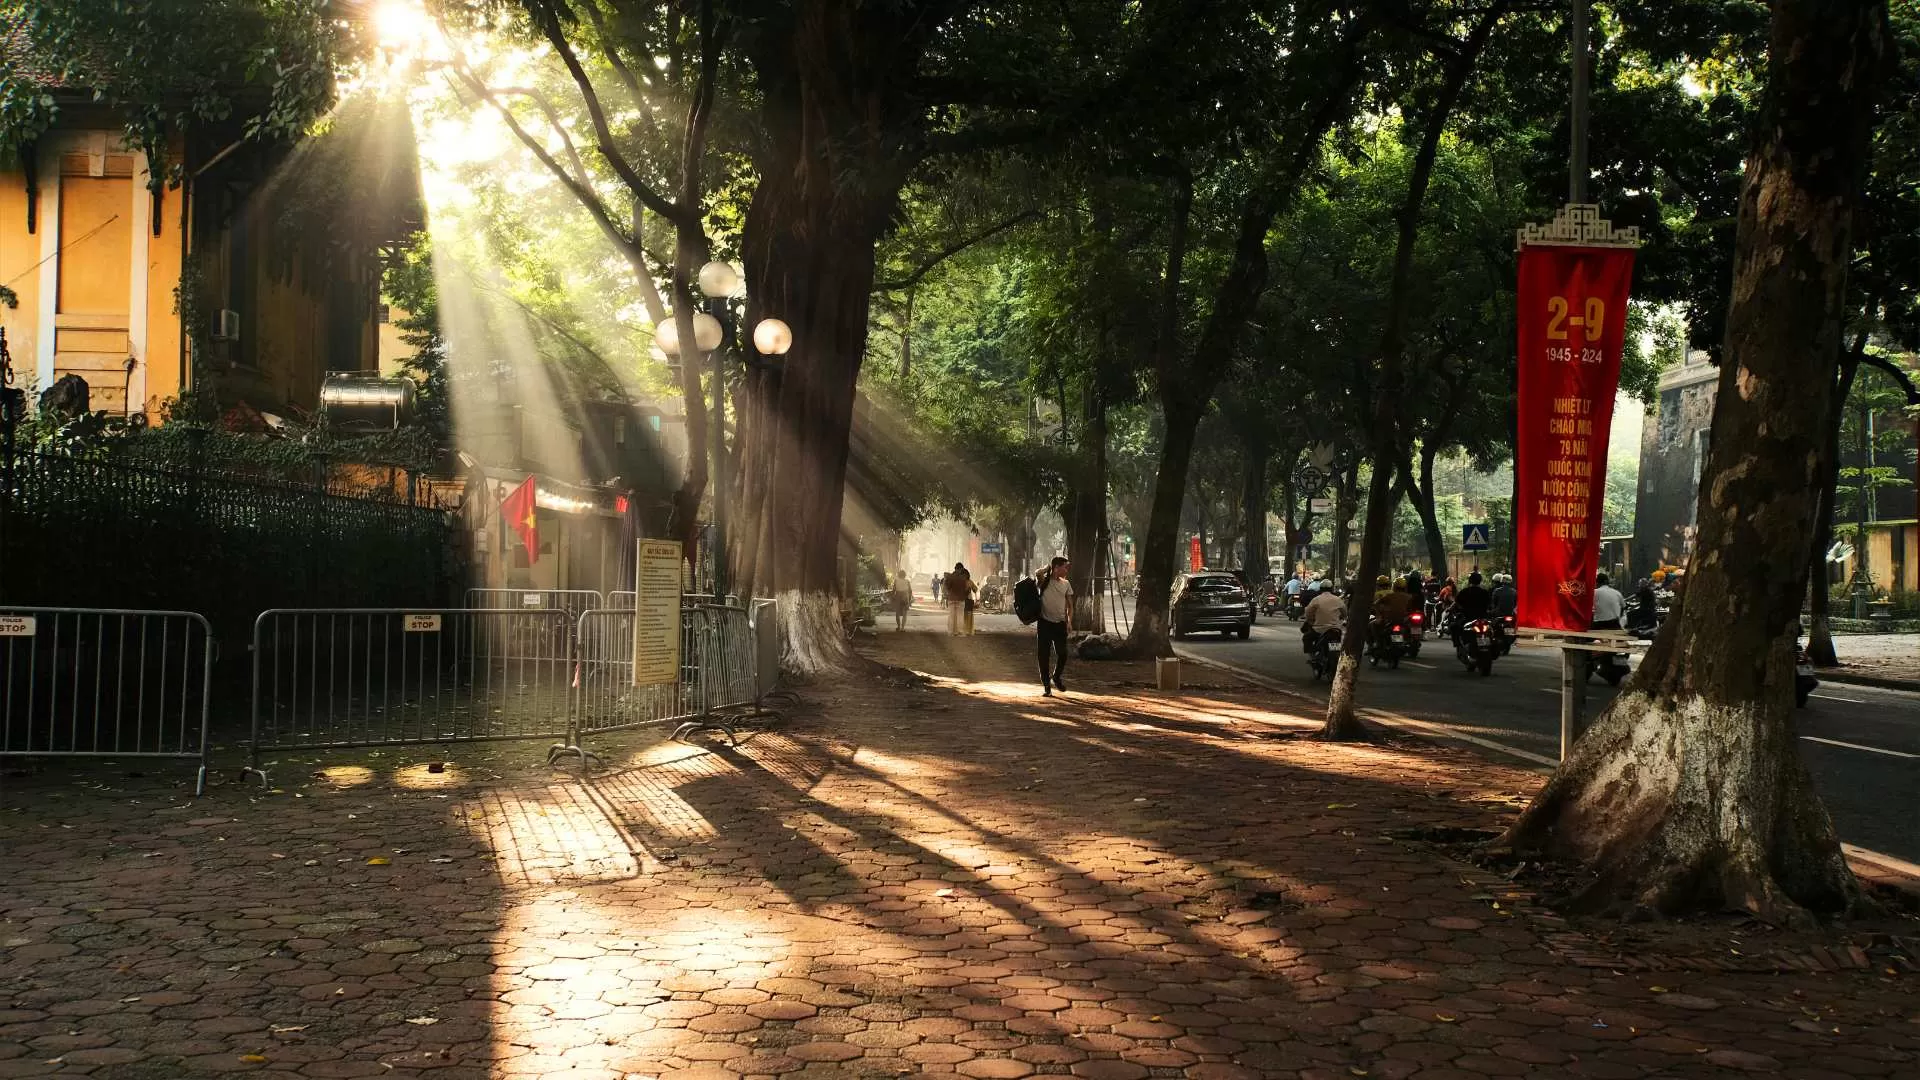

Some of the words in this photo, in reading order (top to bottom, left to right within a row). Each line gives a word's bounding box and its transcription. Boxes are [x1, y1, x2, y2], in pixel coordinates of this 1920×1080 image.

[1547, 295, 1605, 341] 2-9
[1545, 347, 1571, 361] 1945
[1581, 347, 1602, 364] 224
[1560, 440, 1571, 456] 79
[1547, 455, 1572, 477] QUỐC
[1551, 520, 1570, 542] VIỆT
[0, 624, 26, 633] STOP
[411, 621, 434, 629] STOP
